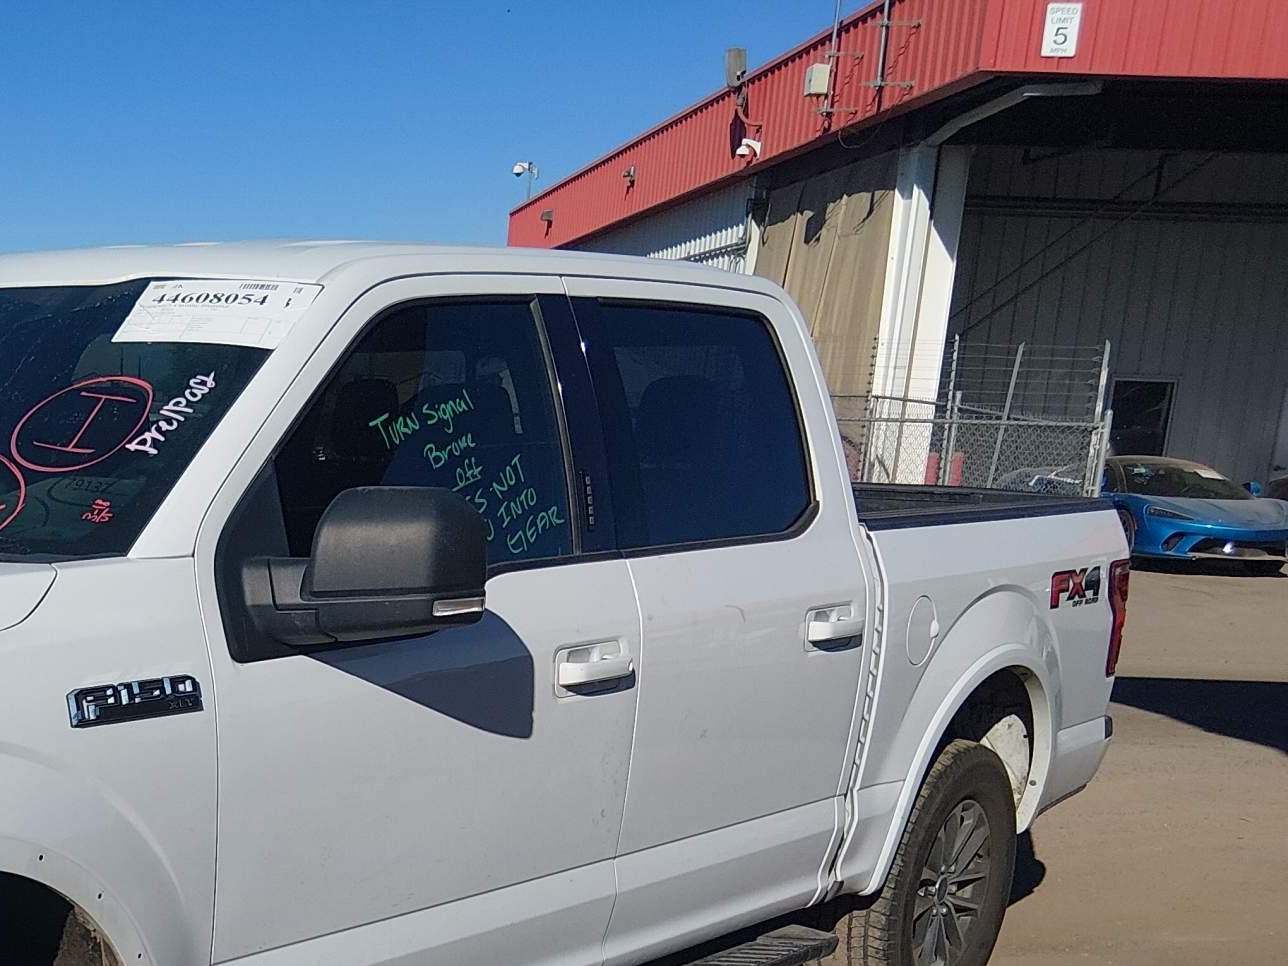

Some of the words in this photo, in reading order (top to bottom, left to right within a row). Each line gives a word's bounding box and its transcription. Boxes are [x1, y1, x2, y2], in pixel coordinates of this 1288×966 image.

[1050, 7, 1078, 15] SPEED
[1053, 26, 1069, 45] 5
[152, 292, 270, 306] 44608054
[423, 390, 474, 434] Signal
[491, 454, 525, 499] NOT
[497, 488, 537, 528] INTO
[1050, 566, 1101, 609] FX4
